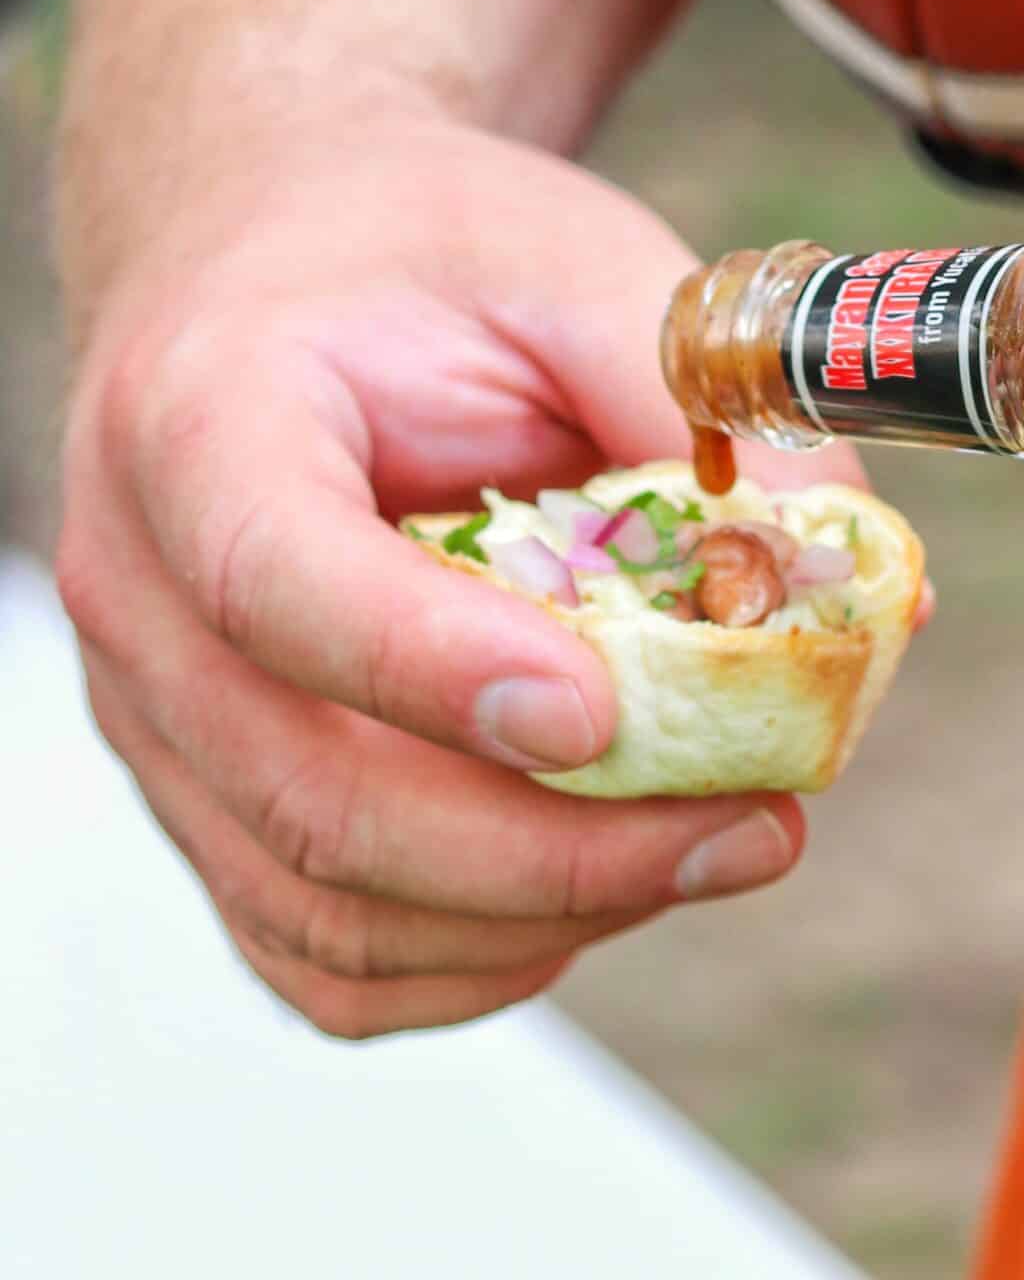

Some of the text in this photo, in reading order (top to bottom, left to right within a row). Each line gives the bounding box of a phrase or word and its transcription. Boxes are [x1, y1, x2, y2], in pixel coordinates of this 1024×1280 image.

[821, 277, 880, 391] Mayan
[871, 260, 945, 380] XXXTRA
[917, 290, 950, 346] from
